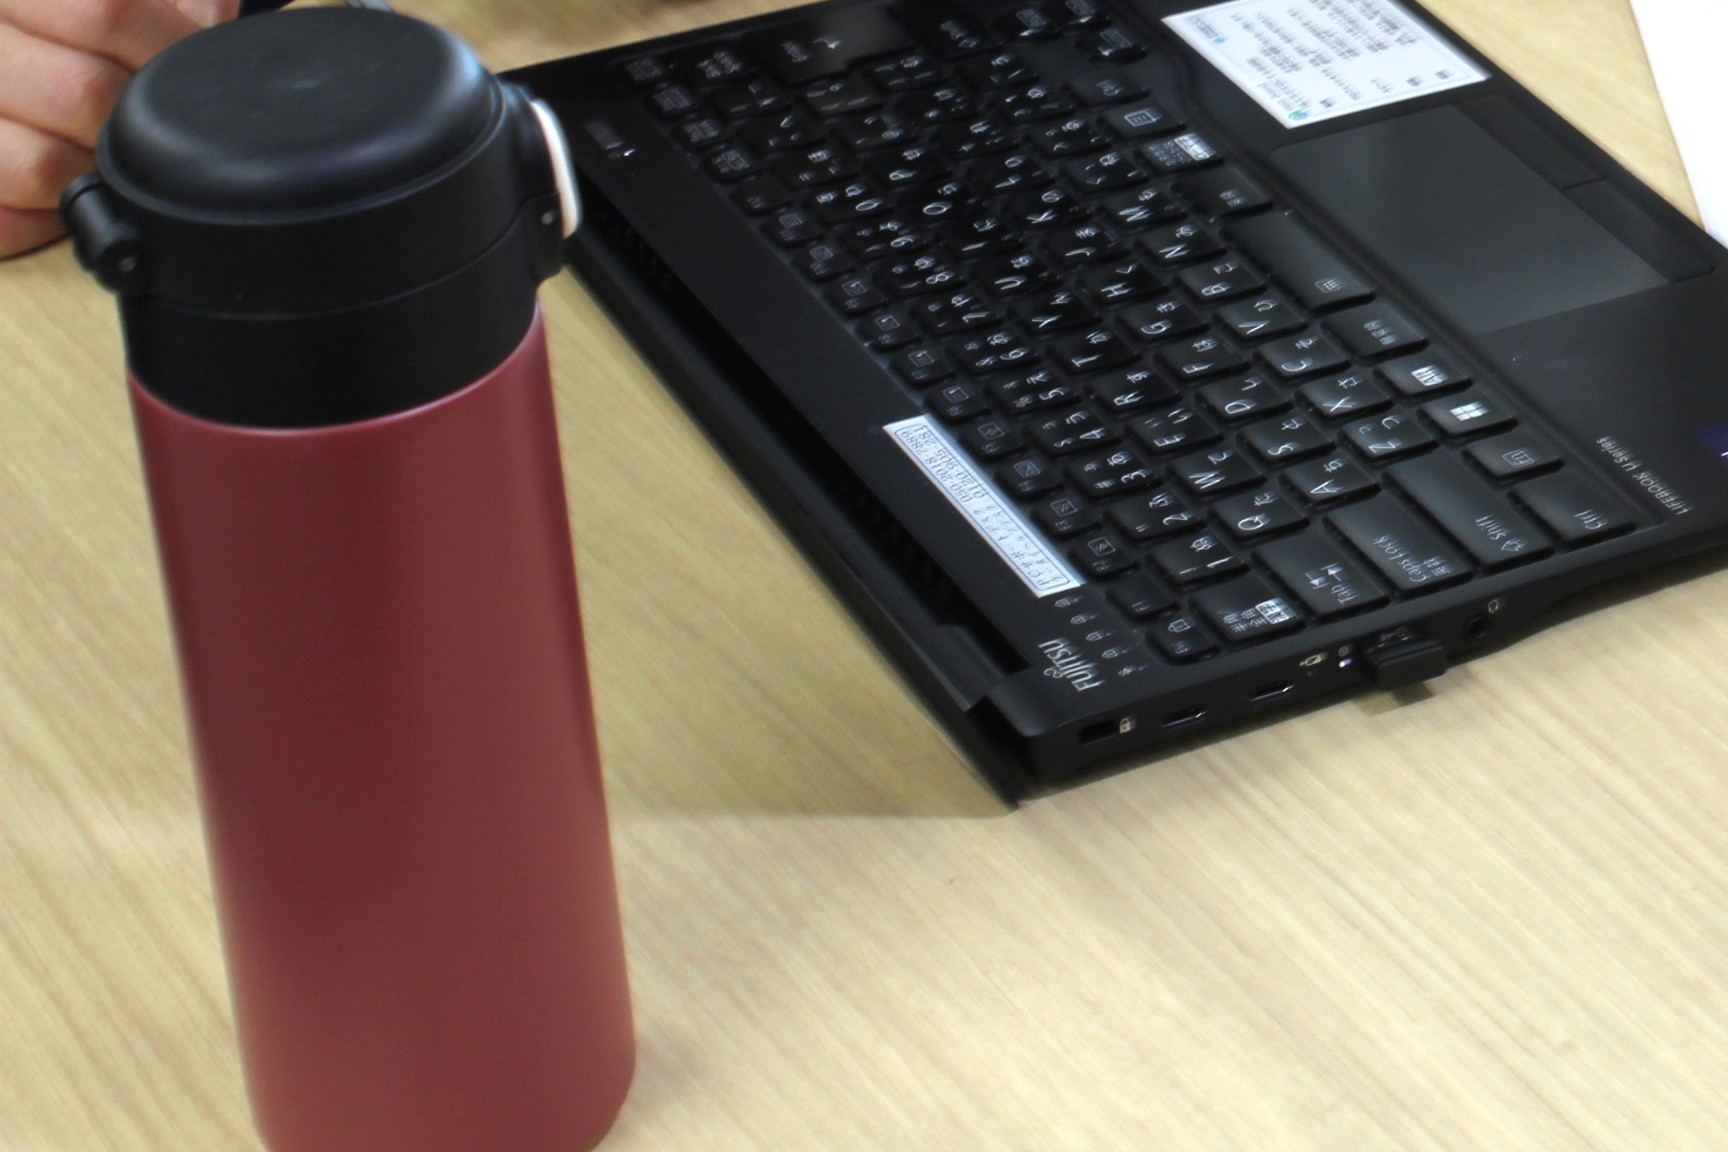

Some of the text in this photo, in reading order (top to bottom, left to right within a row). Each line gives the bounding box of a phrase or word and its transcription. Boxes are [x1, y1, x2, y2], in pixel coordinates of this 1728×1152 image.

[889, 170, 913, 180] P
[995, 177, 1019, 188] L
[1041, 190, 1062, 202] の
[1028, 211, 1053, 223] K
[1119, 207, 1149, 221] M
[974, 220, 996, 231] に
[890, 236, 913, 247] 9
[1160, 245, 1186, 258] N
[1011, 256, 1030, 268] な
[1213, 263, 1235, 274] こ
[926, 271, 951, 284] 8
[995, 276, 1024, 289] U
[1101, 283, 1129, 297] H
[1201, 283, 1228, 295] B
[1254, 300, 1276, 312] ひ
[962, 312, 988, 323] 7
[1032, 317, 1057, 327] Y
[1141, 321, 1169, 334] G
[1238, 323, 1266, 334] V
[987, 333, 1009, 345] お
[1193, 339, 1215, 351] は
[1000, 348, 1026, 360] 6
[1071, 355, 1099, 367] T
[1281, 361, 1310, 371] C
[1183, 364, 1210, 373] F
[1026, 372, 1046, 384] え
[1410, 366, 1442, 386] Alt
[1039, 388, 1064, 400] 5
[1114, 393, 1139, 405] R
[1225, 401, 1253, 414] D
[1323, 398, 1351, 412] X
[1066, 412, 1085, 424] う
[1168, 409, 1189, 423] い
[1079, 428, 1103, 438] 4
[1154, 436, 1180, 446] E
[1368, 441, 1396, 453] Z
[1268, 443, 1293, 455] S
[911, 426, 988, 499] 0120-905-281
[1107, 452, 1127, 466] あ
[1208, 452, 1230, 464] て
[1505, 450, 1534, 465] Fn
[1324, 459, 1342, 472] ち
[1121, 470, 1145, 482] 3
[1189, 472, 1223, 489] W
[1594, 436, 1690, 516] LIFEBOOK U Series
[1310, 481, 1337, 493] A
[1149, 494, 1169, 507] ふ
[1254, 493, 1274, 506] た
[898, 429, 1051, 586] PCサポートデスク 050-2018-7889
[1163, 513, 1190, 525] 2
[1238, 515, 1267, 530] Q
[1574, 510, 1606, 529] Ctrl
[1191, 537, 1212, 551] ぬ
[1373, 536, 1428, 582] Caps Lock
[1331, 584, 1356, 604] Tab
[1253, 598, 1291, 624] 漢字
[1039, 639, 1102, 691] FUJITSU
